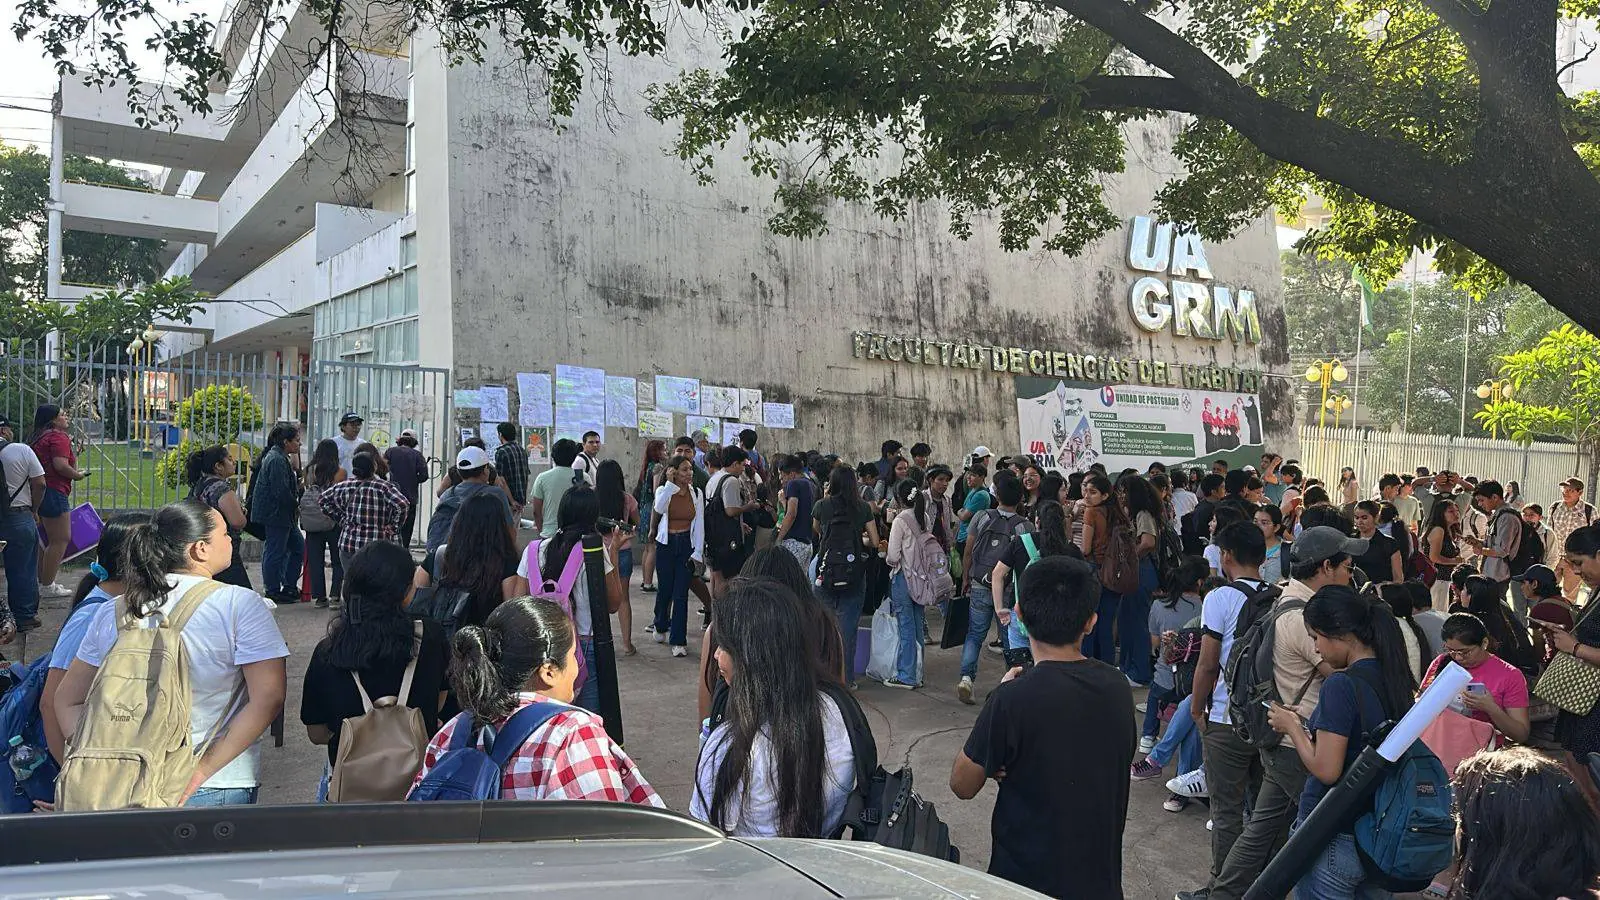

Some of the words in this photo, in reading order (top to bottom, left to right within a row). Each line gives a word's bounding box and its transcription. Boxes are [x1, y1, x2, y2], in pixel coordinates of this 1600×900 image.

[1126, 215, 1214, 280] UA
[1128, 276, 1262, 345] GRM
[852, 330, 984, 369] FACULTAD
[993, 345, 1024, 373] DE
[1029, 349, 1132, 383] CIENCIAS
[1138, 359, 1176, 385] DEL
[1115, 393, 1137, 404] UNIDAD
[1138, 395, 1146, 404] DE
[1147, 396, 1180, 406] POSTGRADO
[1030, 441, 1046, 454] UA
[1035, 454, 1056, 467] RM
